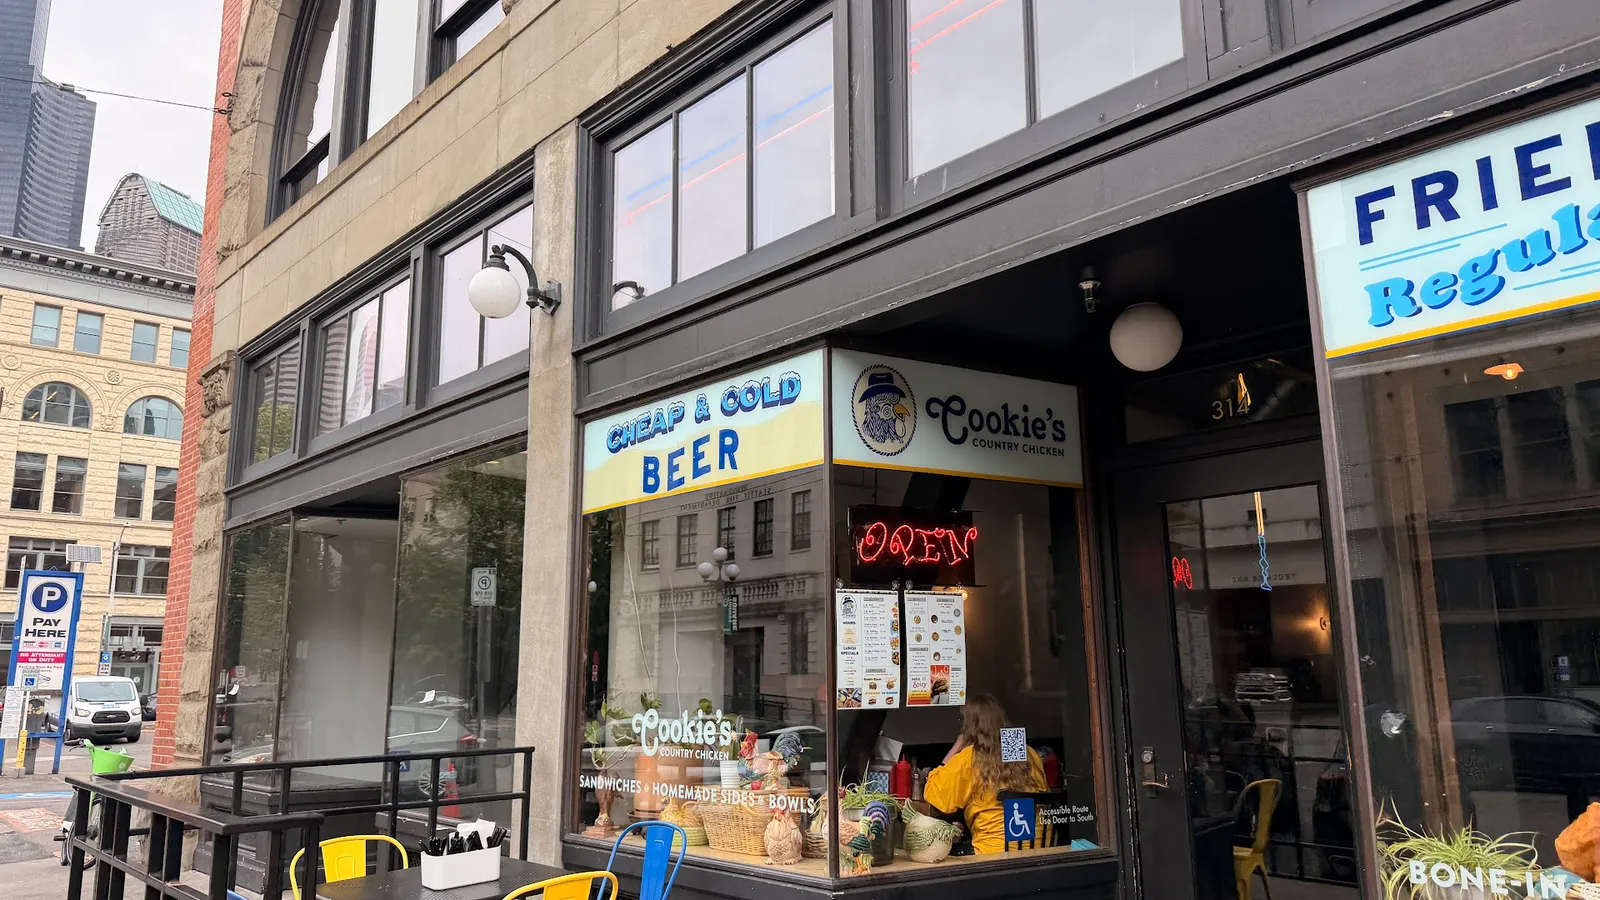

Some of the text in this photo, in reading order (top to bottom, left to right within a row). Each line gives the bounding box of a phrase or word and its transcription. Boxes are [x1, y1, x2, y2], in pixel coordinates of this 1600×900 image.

[606, 370, 802, 454] CHEAP & COLD
[925, 394, 1067, 445] Cookie's
[1212, 395, 1250, 420] 314
[642, 428, 740, 494] BEER
[972, 437, 1065, 457] COUNTRY CHICKEN
[858, 521, 979, 567] OPEN
[24, 628, 67, 638] HERE
[32, 617, 61, 627] PAY
[631, 708, 732, 757] Cookie's
[660, 747, 729, 761] COUNTRY CHICKEN
[579, 774, 815, 814] SANDWICHES HOMEMADE SIDES BOWLS
[1039, 805, 1089, 815] Accessible Route
[1039, 812, 1094, 825] Use Door to South
[1409, 860, 1566, 900] BONE-IN
